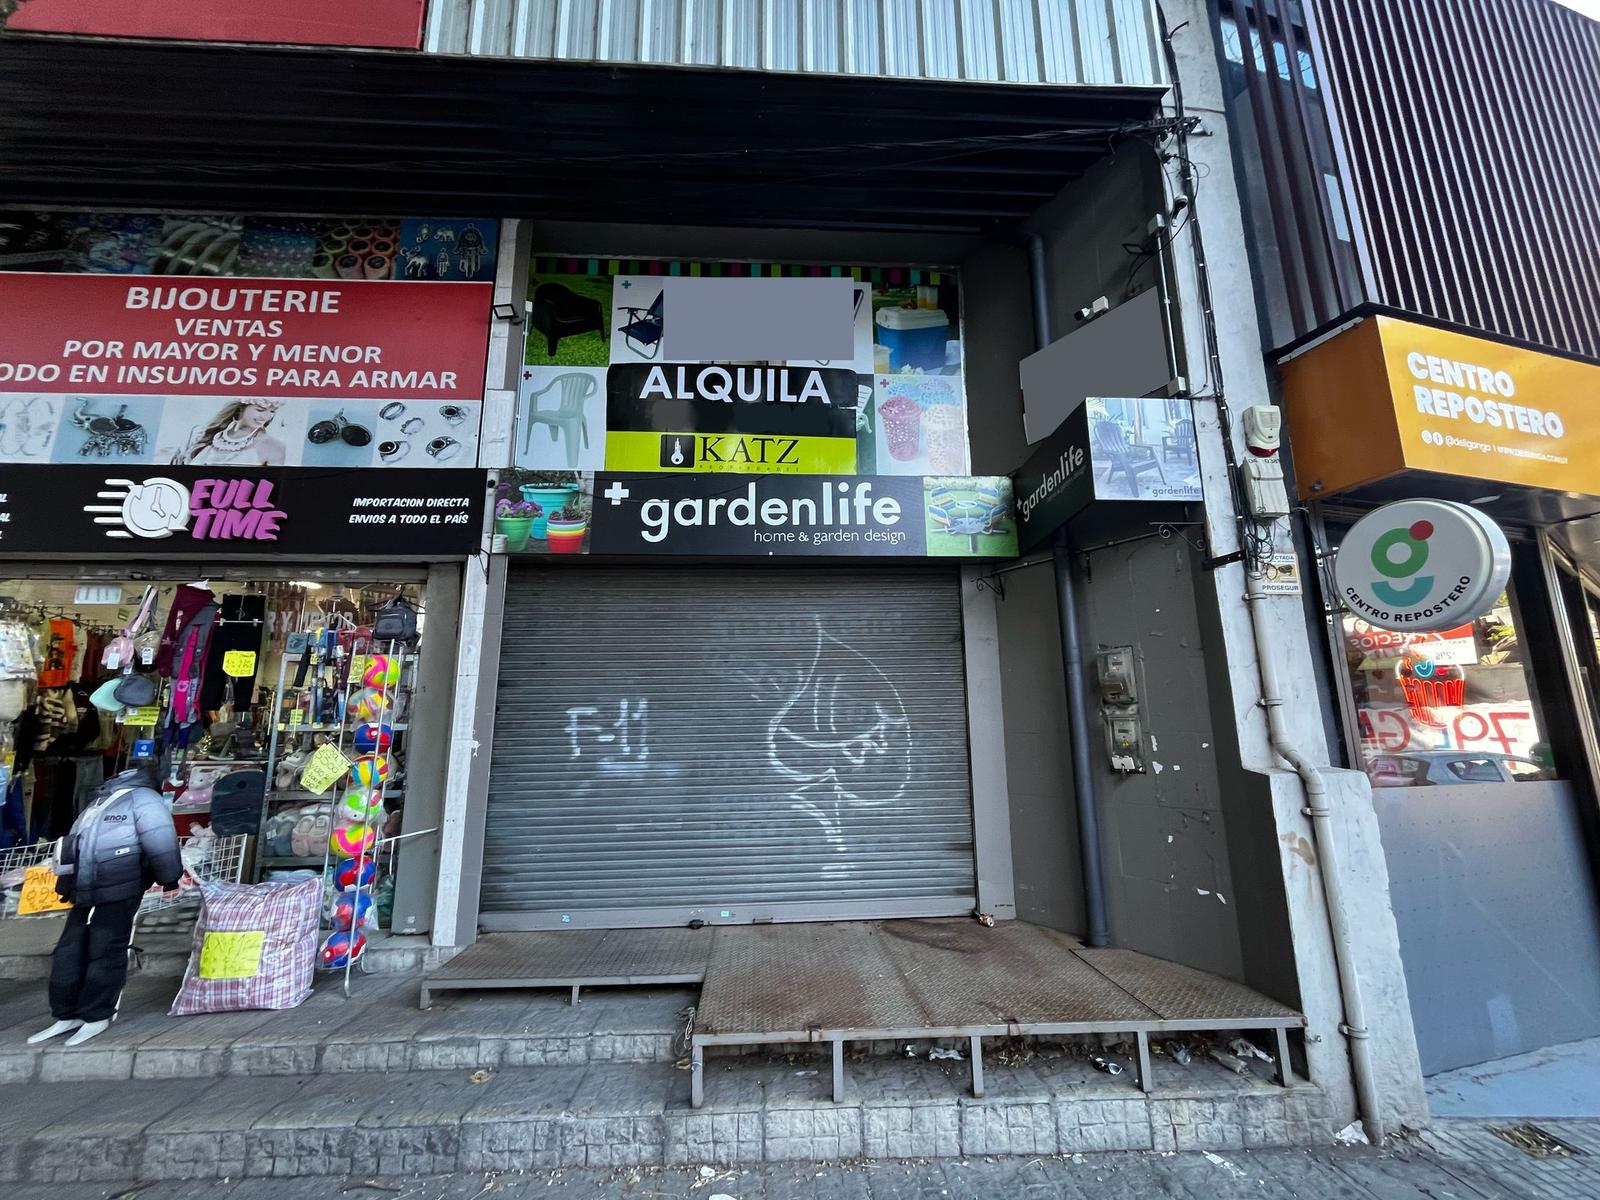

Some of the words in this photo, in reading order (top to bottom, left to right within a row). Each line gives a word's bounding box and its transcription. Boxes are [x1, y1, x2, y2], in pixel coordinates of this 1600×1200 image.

[125, 286, 342, 313] BIJOUTERIE
[175, 318, 283, 338] VENTAS
[63, 340, 125, 359] POR
[132, 342, 239, 361] MAYOR
[248, 343, 266, 361] Y
[273, 344, 382, 364] MENOR
[0, 363, 60, 383] ODO
[69, 364, 109, 383] EN
[117, 365, 258, 385] INSUMOS
[266, 368, 341, 387] PARA
[349, 370, 457, 389] ARMAR
[639, 366, 831, 404] ALQUILA
[1407, 351, 1515, 397] CENTRO
[1413, 385, 1564, 439] REPOSTERO
[699, 436, 800, 464] KATZ
[189, 479, 275, 509] FULL
[1022, 445, 1084, 522] gardenlife
[1153, 485, 1201, 498] gardenlife
[353, 497, 425, 507] IMPORTACION
[426, 497, 470, 507] DIRECTA
[640, 482, 901, 543] gardenlife
[190, 508, 288, 540] TIME
[348, 514, 387, 524] ENVIOS
[388, 514, 397, 524] A
[399, 514, 428, 524] TODO
[429, 514, 441, 524] EL
[444, 511, 469, 524] PAÍS
[754, 529, 795, 542] home
[798, 531, 809, 542] &
[813, 529, 859, 545] garden
[864, 529, 906, 545] design
[1346, 587, 1390, 621] CENTRO
[1394, 576, 1471, 622] REPOSTERO
